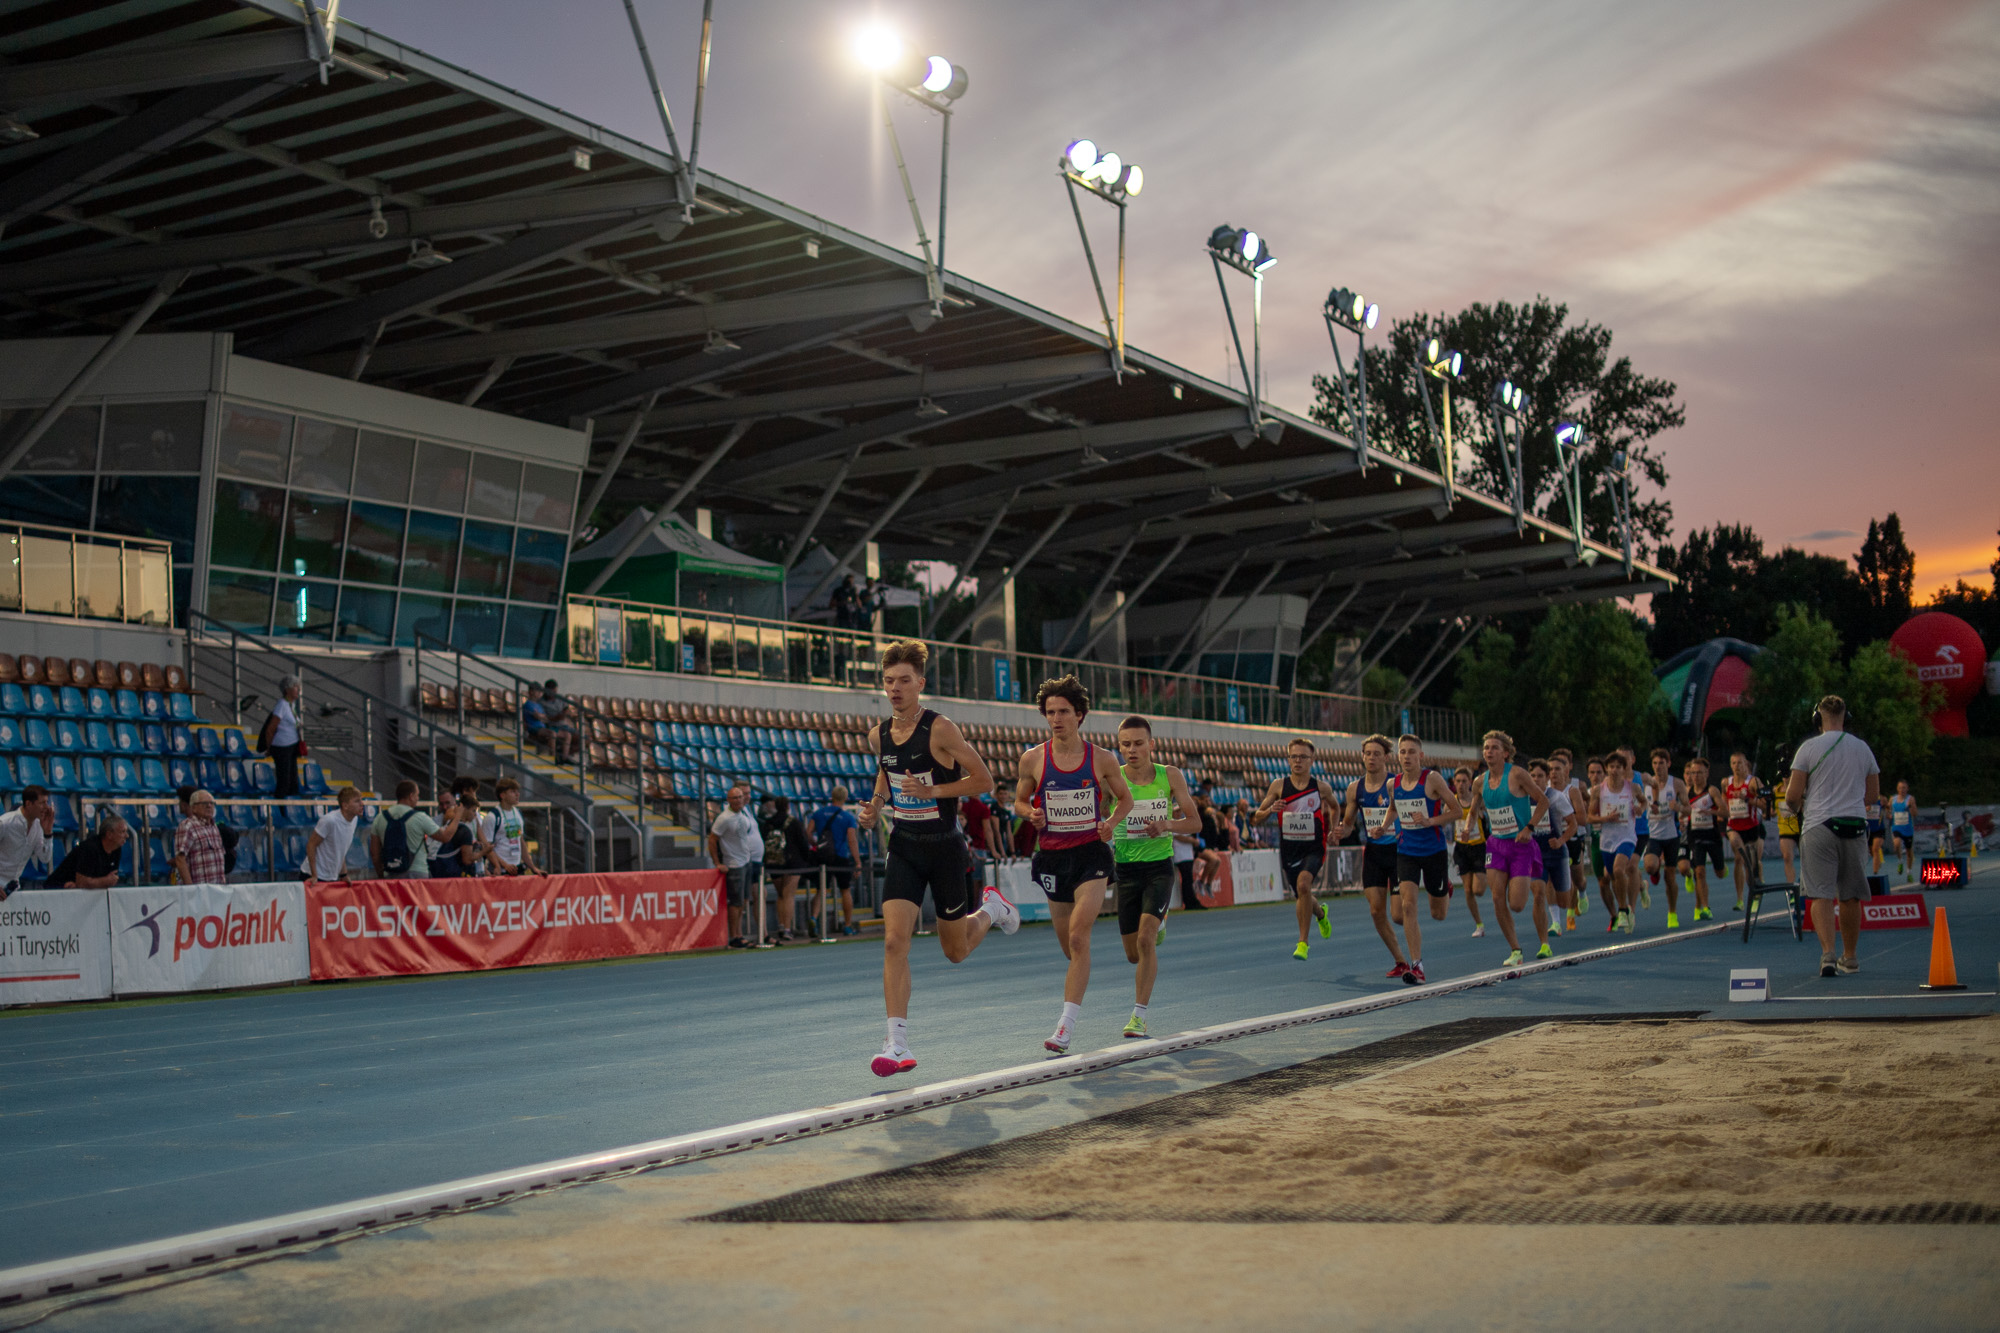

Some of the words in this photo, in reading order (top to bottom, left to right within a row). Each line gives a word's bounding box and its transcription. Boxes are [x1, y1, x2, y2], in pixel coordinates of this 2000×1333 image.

[600, 629, 619, 650] E-H
[1921, 667, 1961, 679] ORLEN
[999, 670, 1006, 696] F
[1073, 791, 1091, 800] 497
[1048, 803, 1093, 817] TWARDOŃ
[1151, 801, 1167, 809] 162
[1289, 823, 1307, 831] PAJA
[1043, 875, 1052, 891] 6
[322, 906, 418, 938] POLSKI
[425, 899, 539, 939] ZWIĄZEK
[542, 893, 626, 928] LEKKIEJ
[630, 888, 720, 922] ATLETYKI
[1868, 908, 1917, 919] ORLEN
[173, 898, 287, 962] polanik
[16, 934, 80, 958] Turystyki
